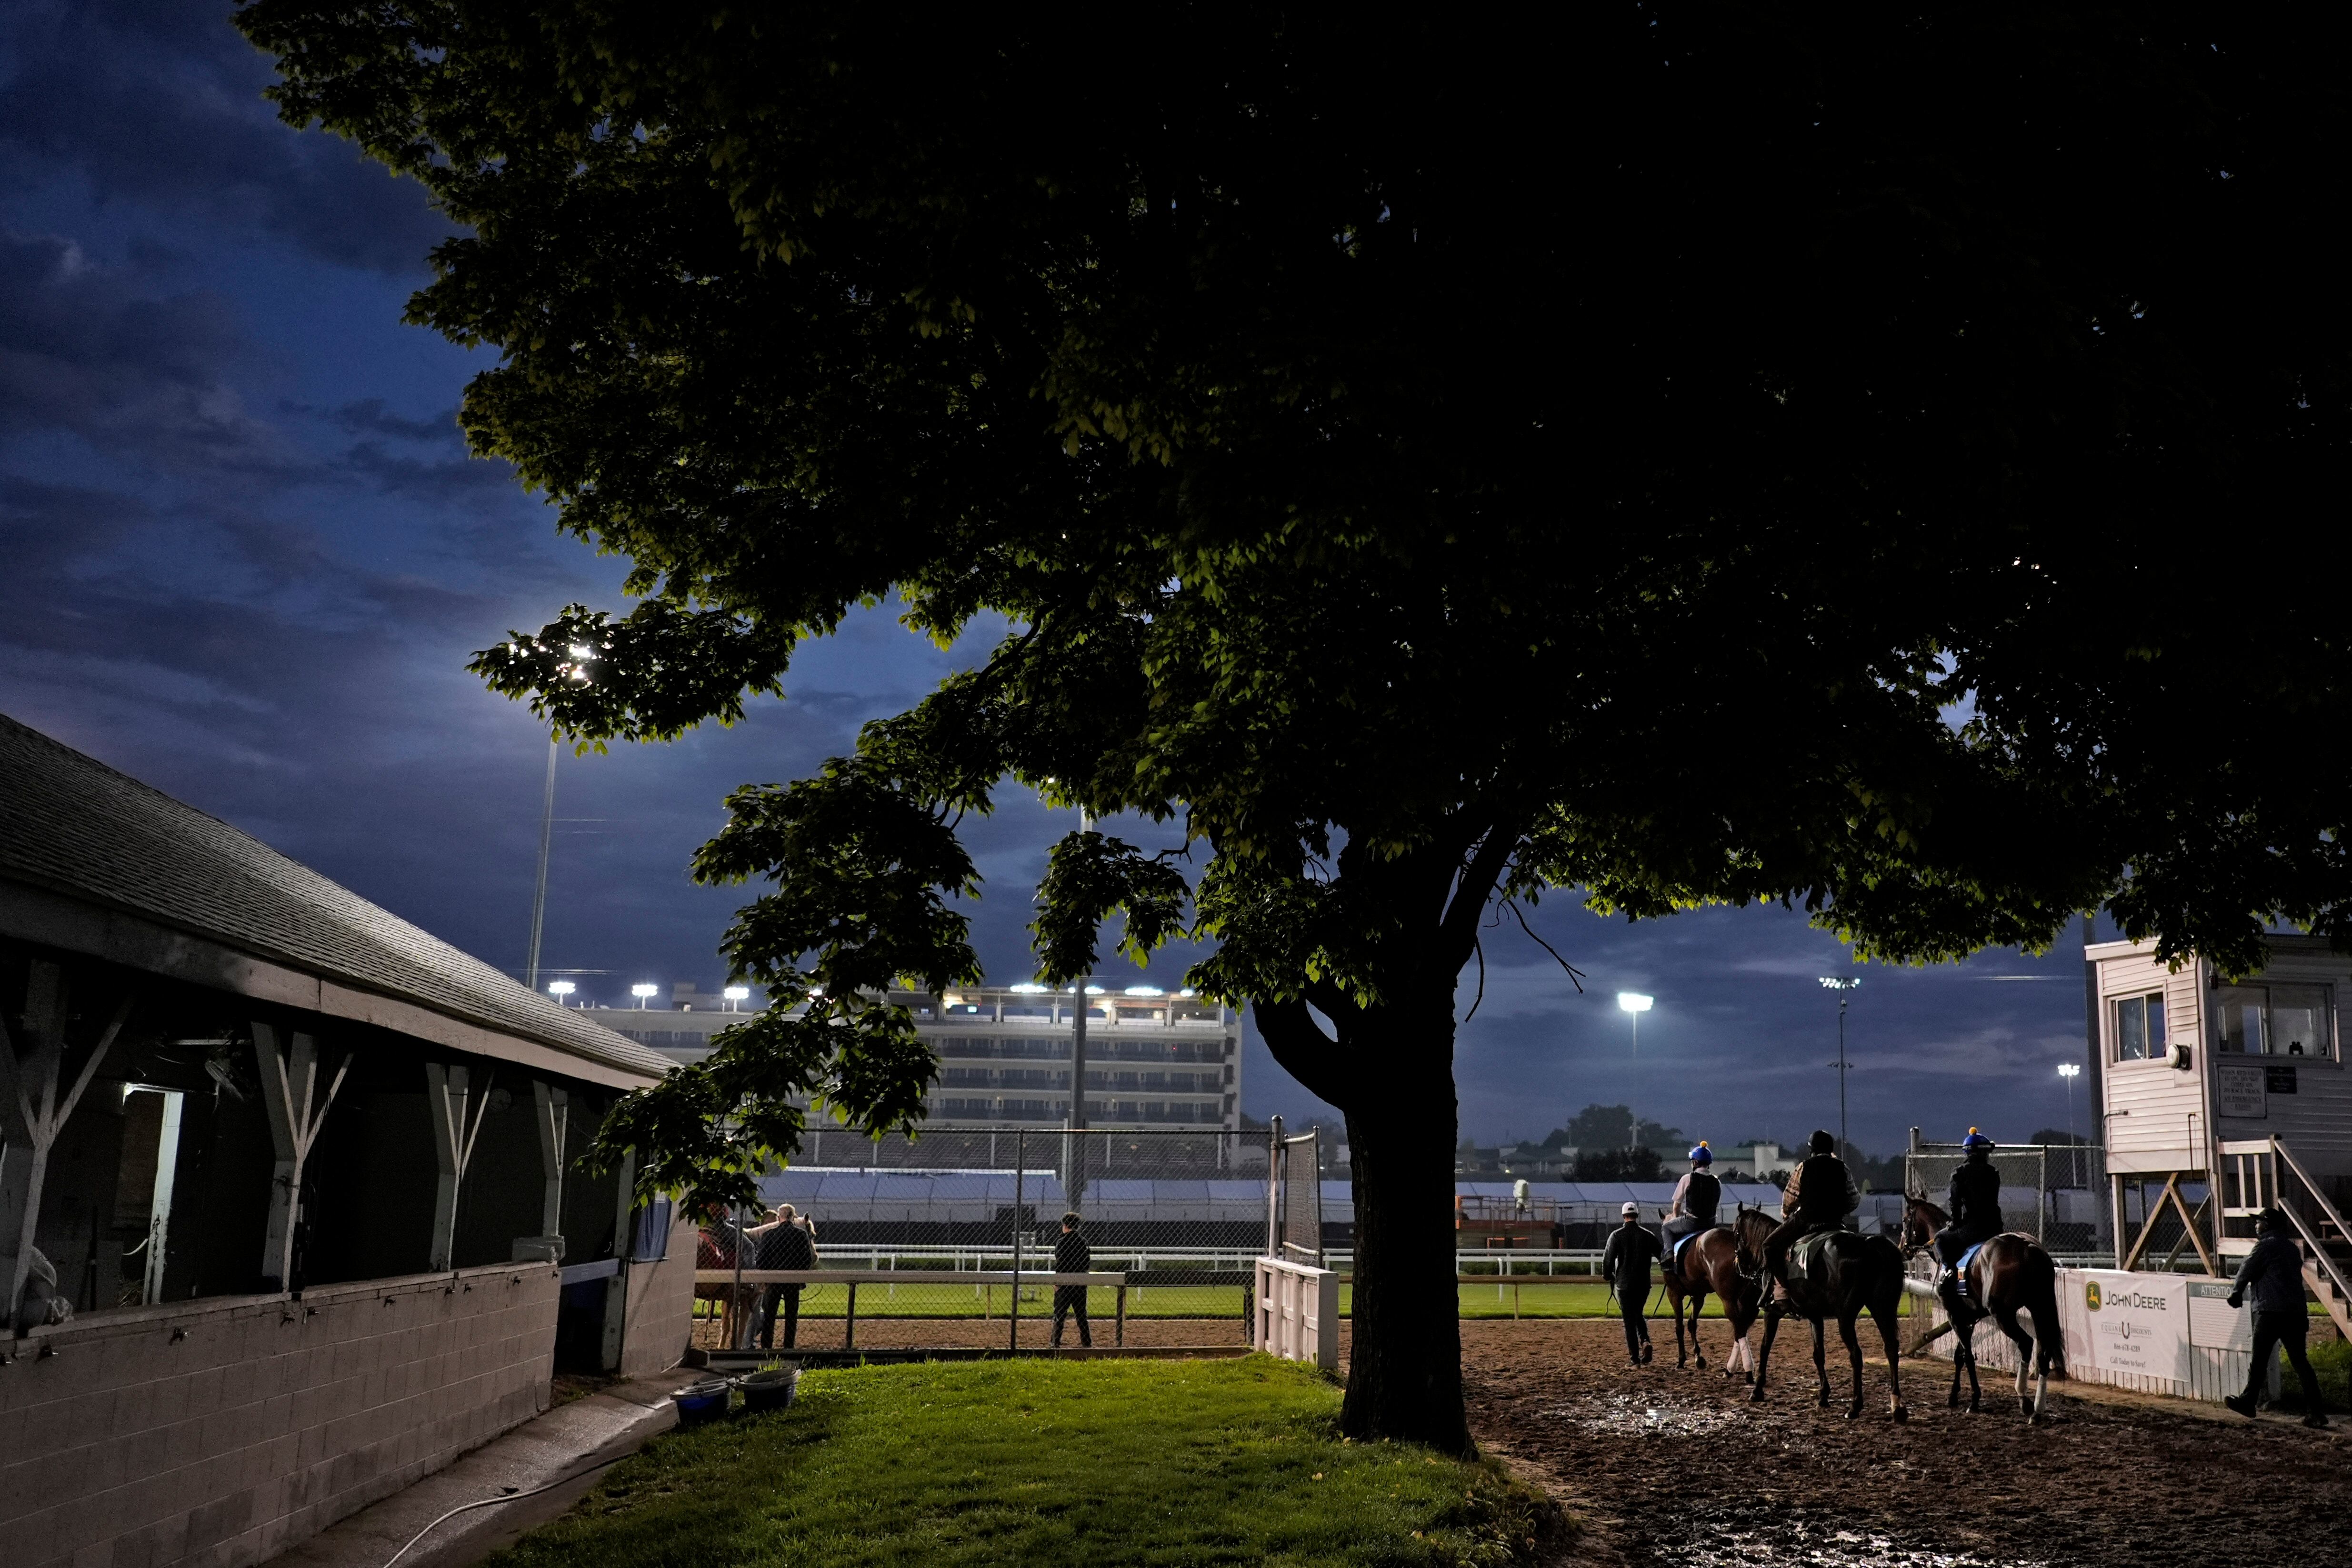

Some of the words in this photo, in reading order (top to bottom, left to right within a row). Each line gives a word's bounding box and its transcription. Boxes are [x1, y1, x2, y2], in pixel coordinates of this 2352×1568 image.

[2106, 1290, 2131, 1307] JOHN
[2133, 1292, 2166, 1310] DEERE
[2130, 1328, 2152, 1336] DISCOUNTS
[2119, 1358, 2130, 1368] Today
[2135, 1360, 2146, 1368] Save!
